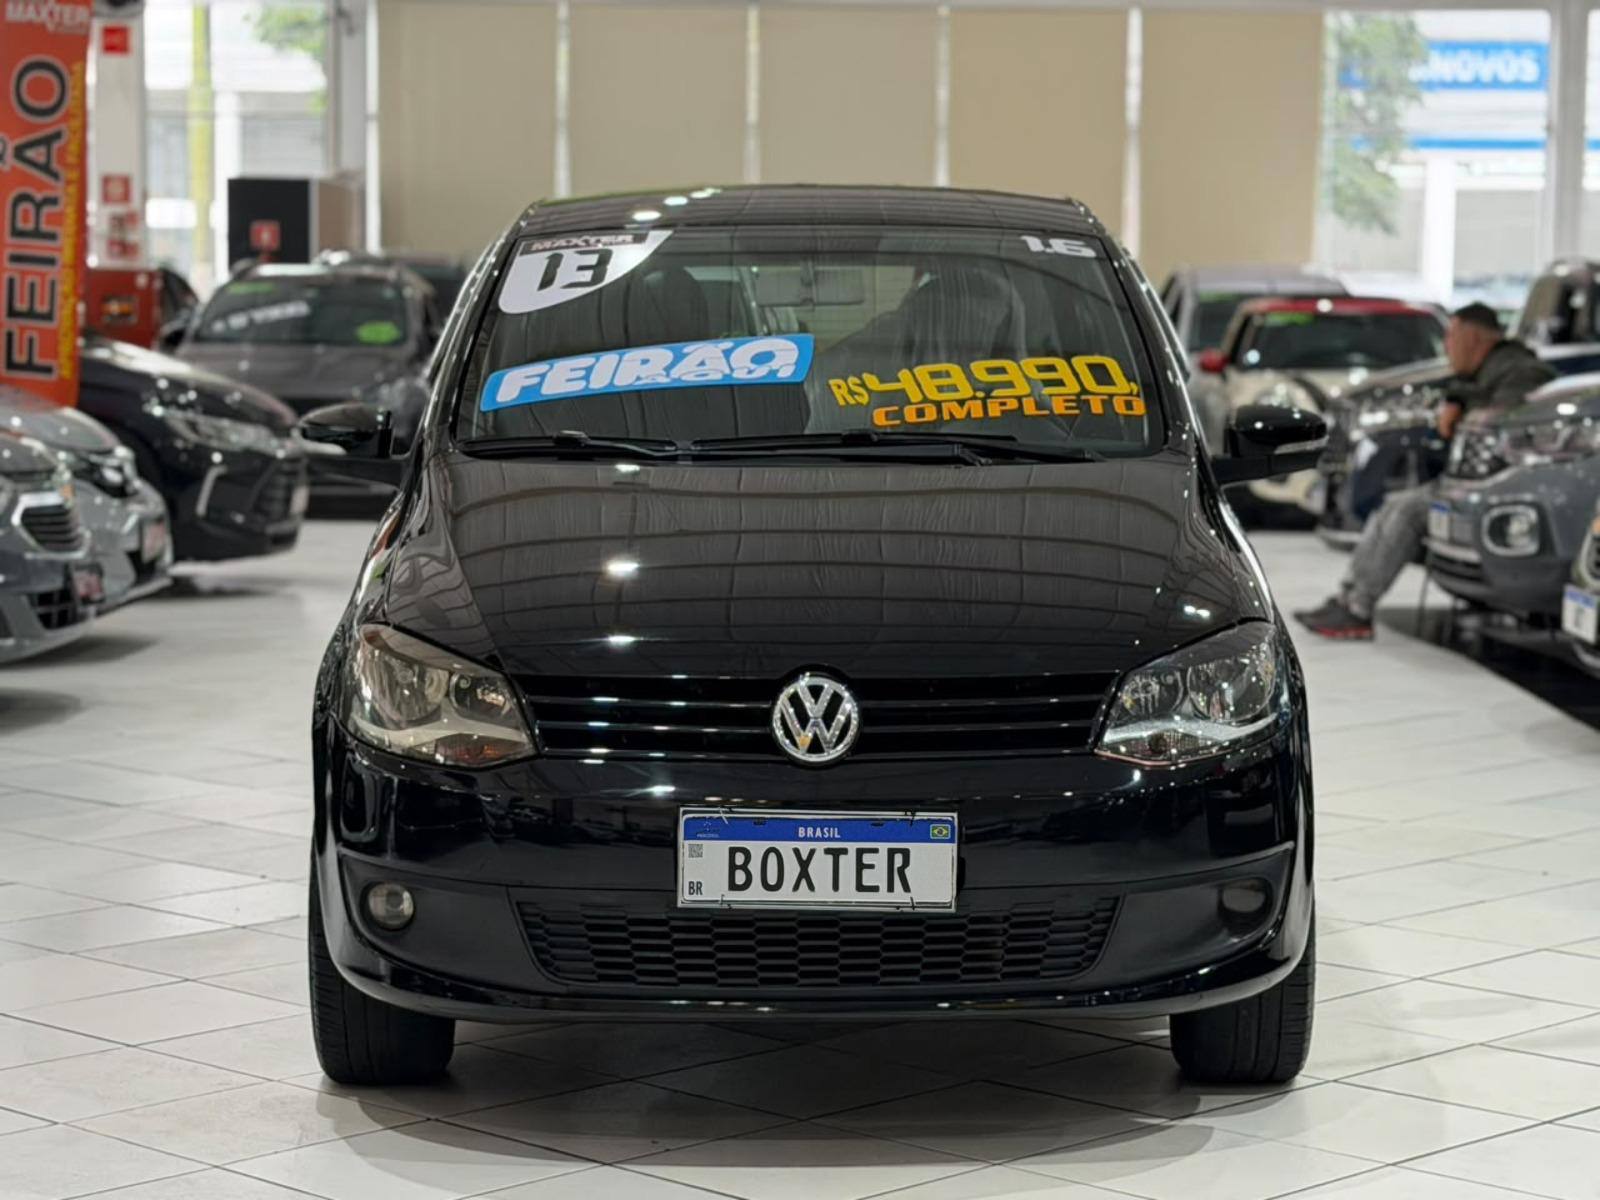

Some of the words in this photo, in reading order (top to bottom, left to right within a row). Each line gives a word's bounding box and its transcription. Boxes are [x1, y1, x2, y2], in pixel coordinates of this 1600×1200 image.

[1020, 235, 1097, 258] 1.6
[537, 249, 613, 291] 13
[496, 338, 799, 402] FEIRÃO
[872, 394, 1147, 427] COMPLETO
[798, 827, 841, 839] BRASIL
[728, 846, 911, 893] BOXTER
[688, 880, 703, 896] BR
